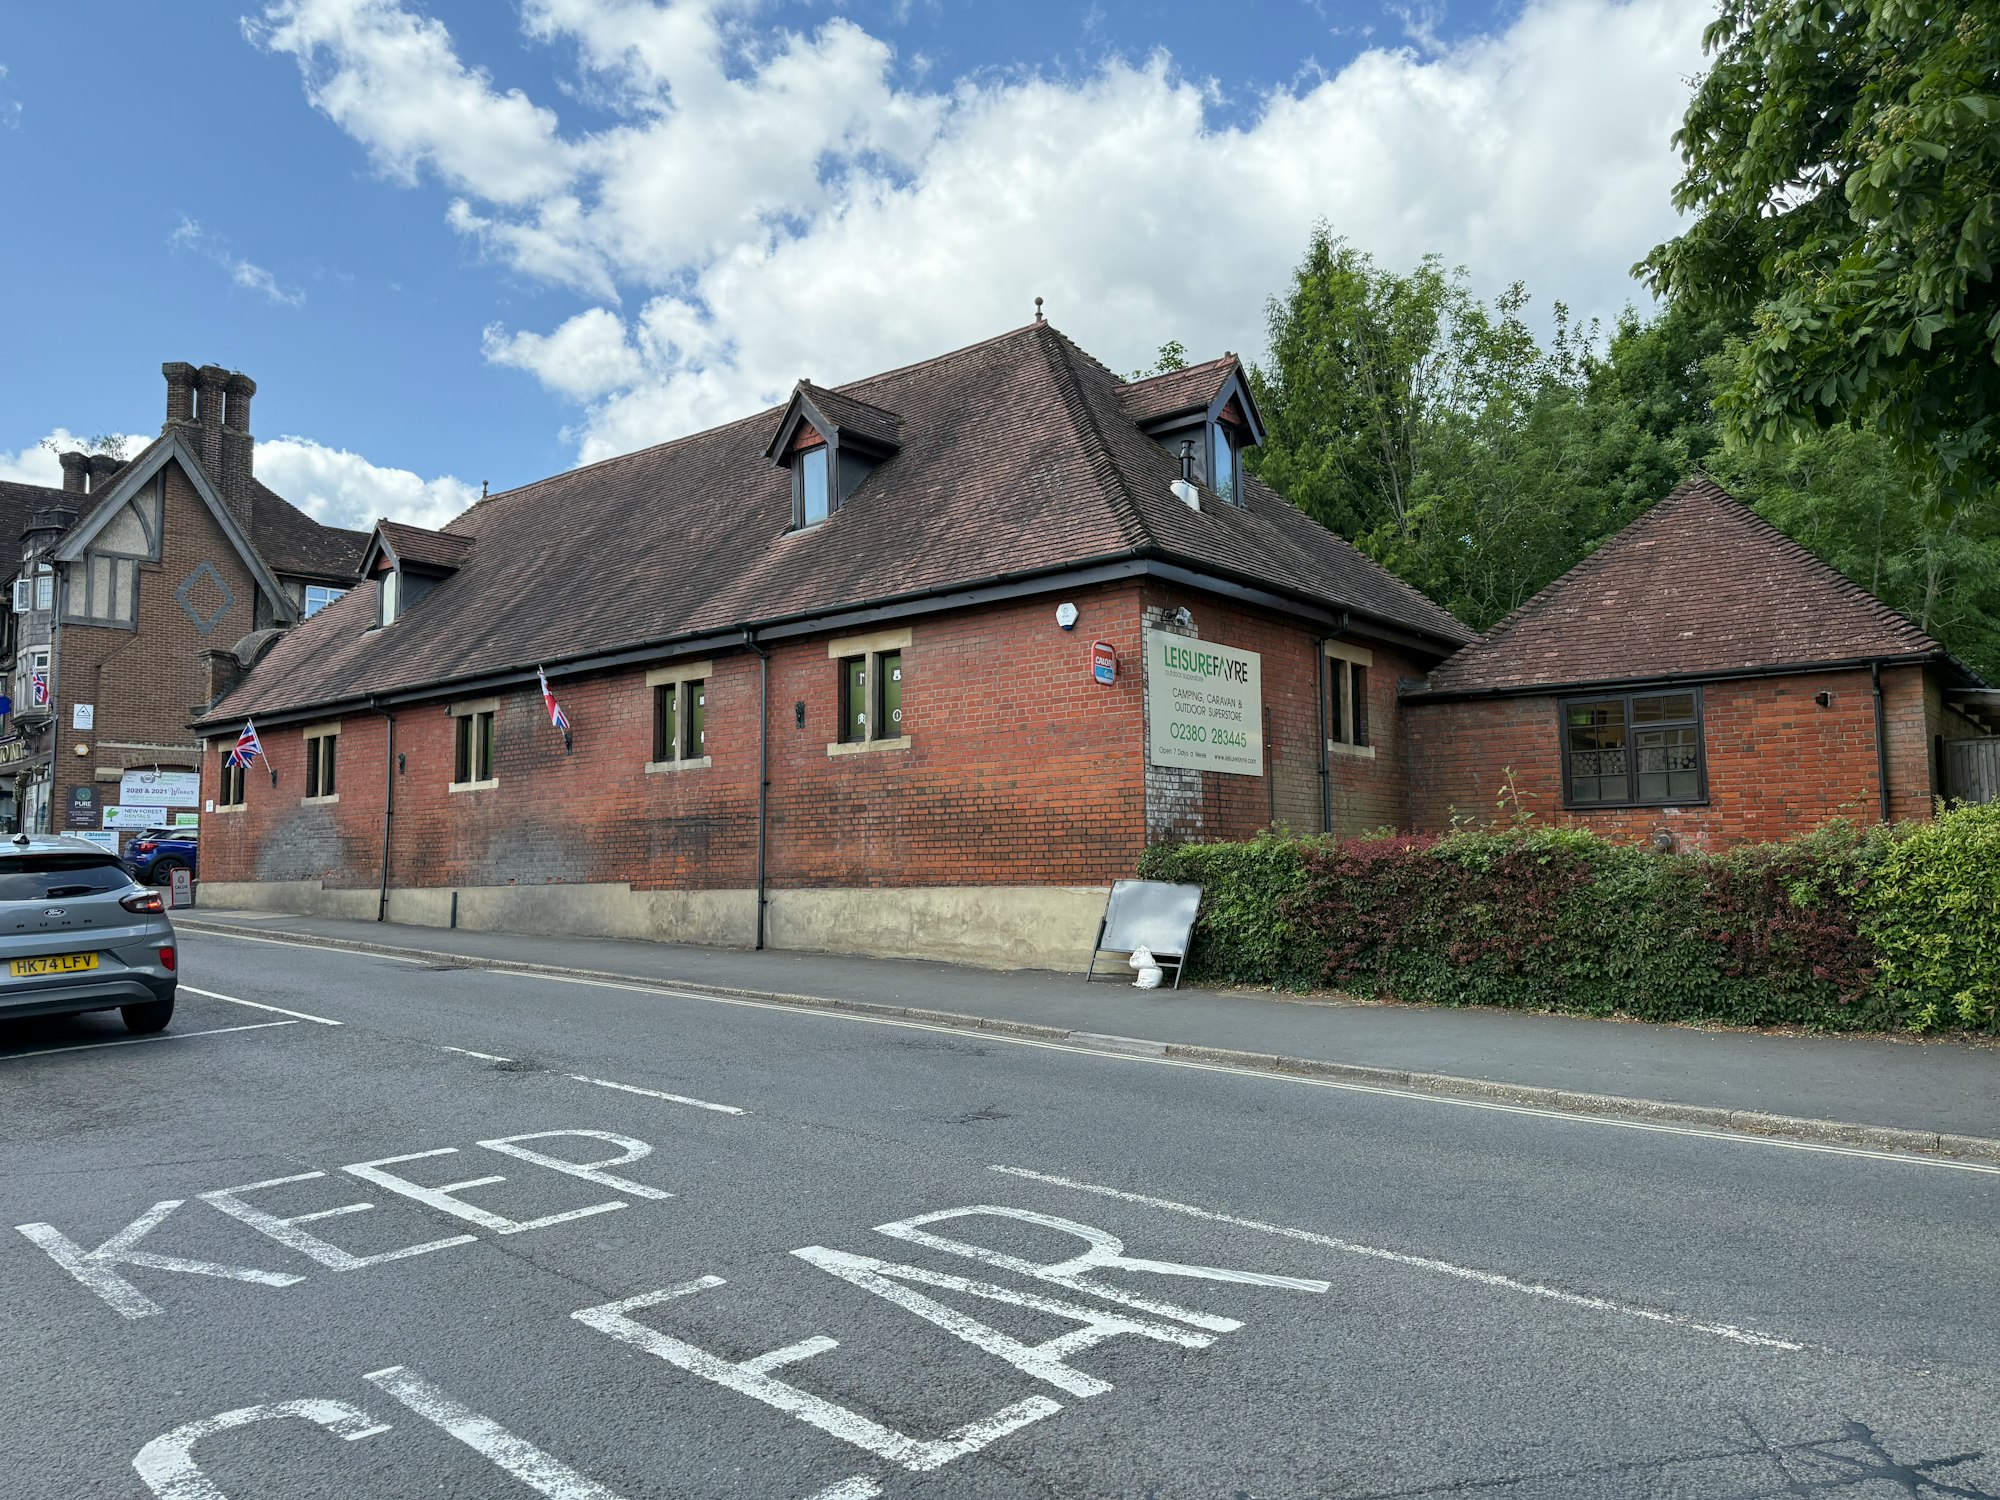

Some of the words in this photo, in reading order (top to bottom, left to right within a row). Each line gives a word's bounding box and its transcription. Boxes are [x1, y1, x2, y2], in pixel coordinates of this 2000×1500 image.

[1164, 645, 1248, 684] LEISUREFAYRE
[1164, 669, 1182, 679] outdoor
[1182, 673, 1204, 683] superstore
[1172, 687, 1205, 704] CAMPING,
[1206, 694, 1236, 708] CARAVAN
[1238, 699, 1243, 709] &
[1174, 701, 1206, 716] OUTDOOR
[1208, 707, 1242, 721] SUPERSTORE
[1170, 722, 1207, 742] 02380
[1211, 728, 1247, 748] 283445
[1159, 746, 1172, 755] Open
[1177, 748, 1189, 757] Days
[1195, 750, 1207, 759] Week
[16, 958, 58, 974] HK74
[62, 955, 91, 970] LFV
[14, 1129, 675, 1320] KEEP
